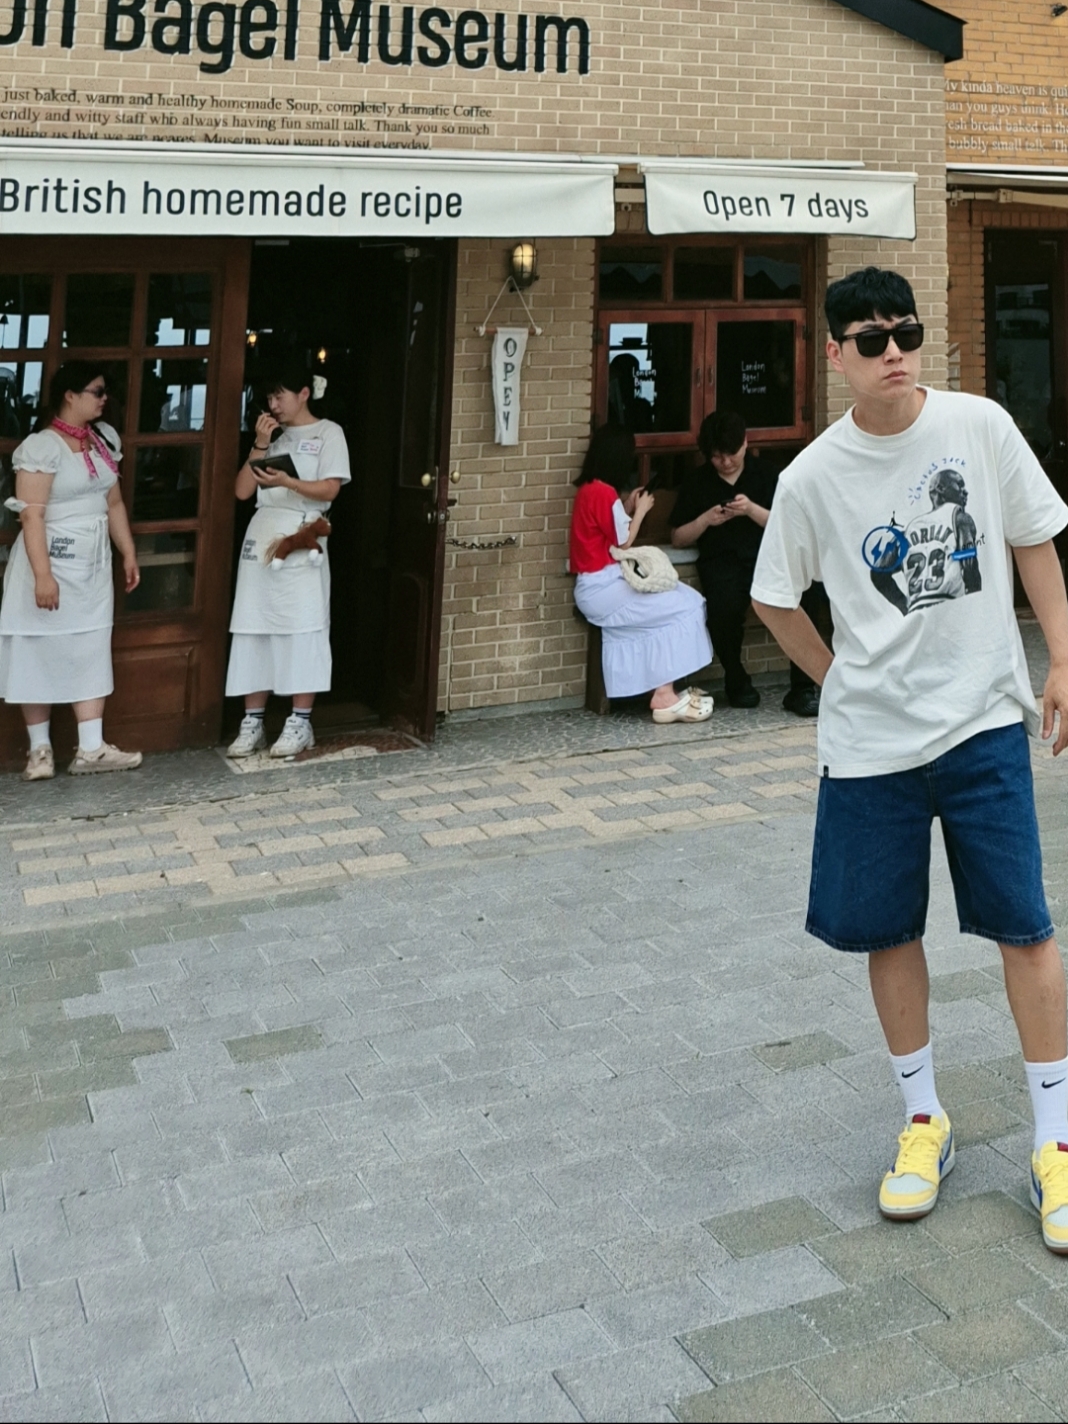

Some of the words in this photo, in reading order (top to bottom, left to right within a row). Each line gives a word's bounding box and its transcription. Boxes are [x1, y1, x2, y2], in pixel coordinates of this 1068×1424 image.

[961, 80, 992, 93] kinda
[996, 81, 1035, 95] heaven
[1038, 83, 1047, 95] is
[3, 87, 29, 103] just
[34, 88, 80, 104] baked,
[86, 94, 124, 104] warm
[129, 93, 153, 106] and
[158, 93, 207, 110] healthy
[211, 95, 282, 110] homemade
[286, 99, 322, 113] Soup,
[326, 101, 395, 116] completely
[398, 103, 449, 116] dramatic
[453, 105, 495, 118] Coffee.
[967, 102, 987, 115] you
[991, 104, 1017, 117] guys
[0, 107, 40, 123] endly
[45, 109, 70, 122] and
[75, 110, 111, 125] witty
[115, 112, 147, 124] staff
[150, 113, 178, 125] who
[182, 113, 228, 129] always
[232, 115, 277, 131] having
[281, 117, 301, 128] fun
[305, 118, 339, 130] small
[343, 119, 370, 132] talk.
[374, 120, 411, 133] Thank
[415, 123, 437, 135] you
[441, 124, 455, 133] so
[457, 124, 490, 135] much
[971, 117, 1002, 132] bread
[1005, 119, 1038, 133] baked
[1042, 120, 1052, 133] in
[949, 136, 988, 153] bubbly
[992, 138, 1022, 151] small
[0, 178, 126, 214] British
[142, 181, 346, 217] homemade
[361, 185, 462, 224] recipe
[703, 190, 771, 221] Open
[780, 194, 795, 217] 7
[808, 192, 869, 223] days
[741, 360, 765, 373] London
[51, 536, 75, 545] London
[907, 548, 946, 596] 23
